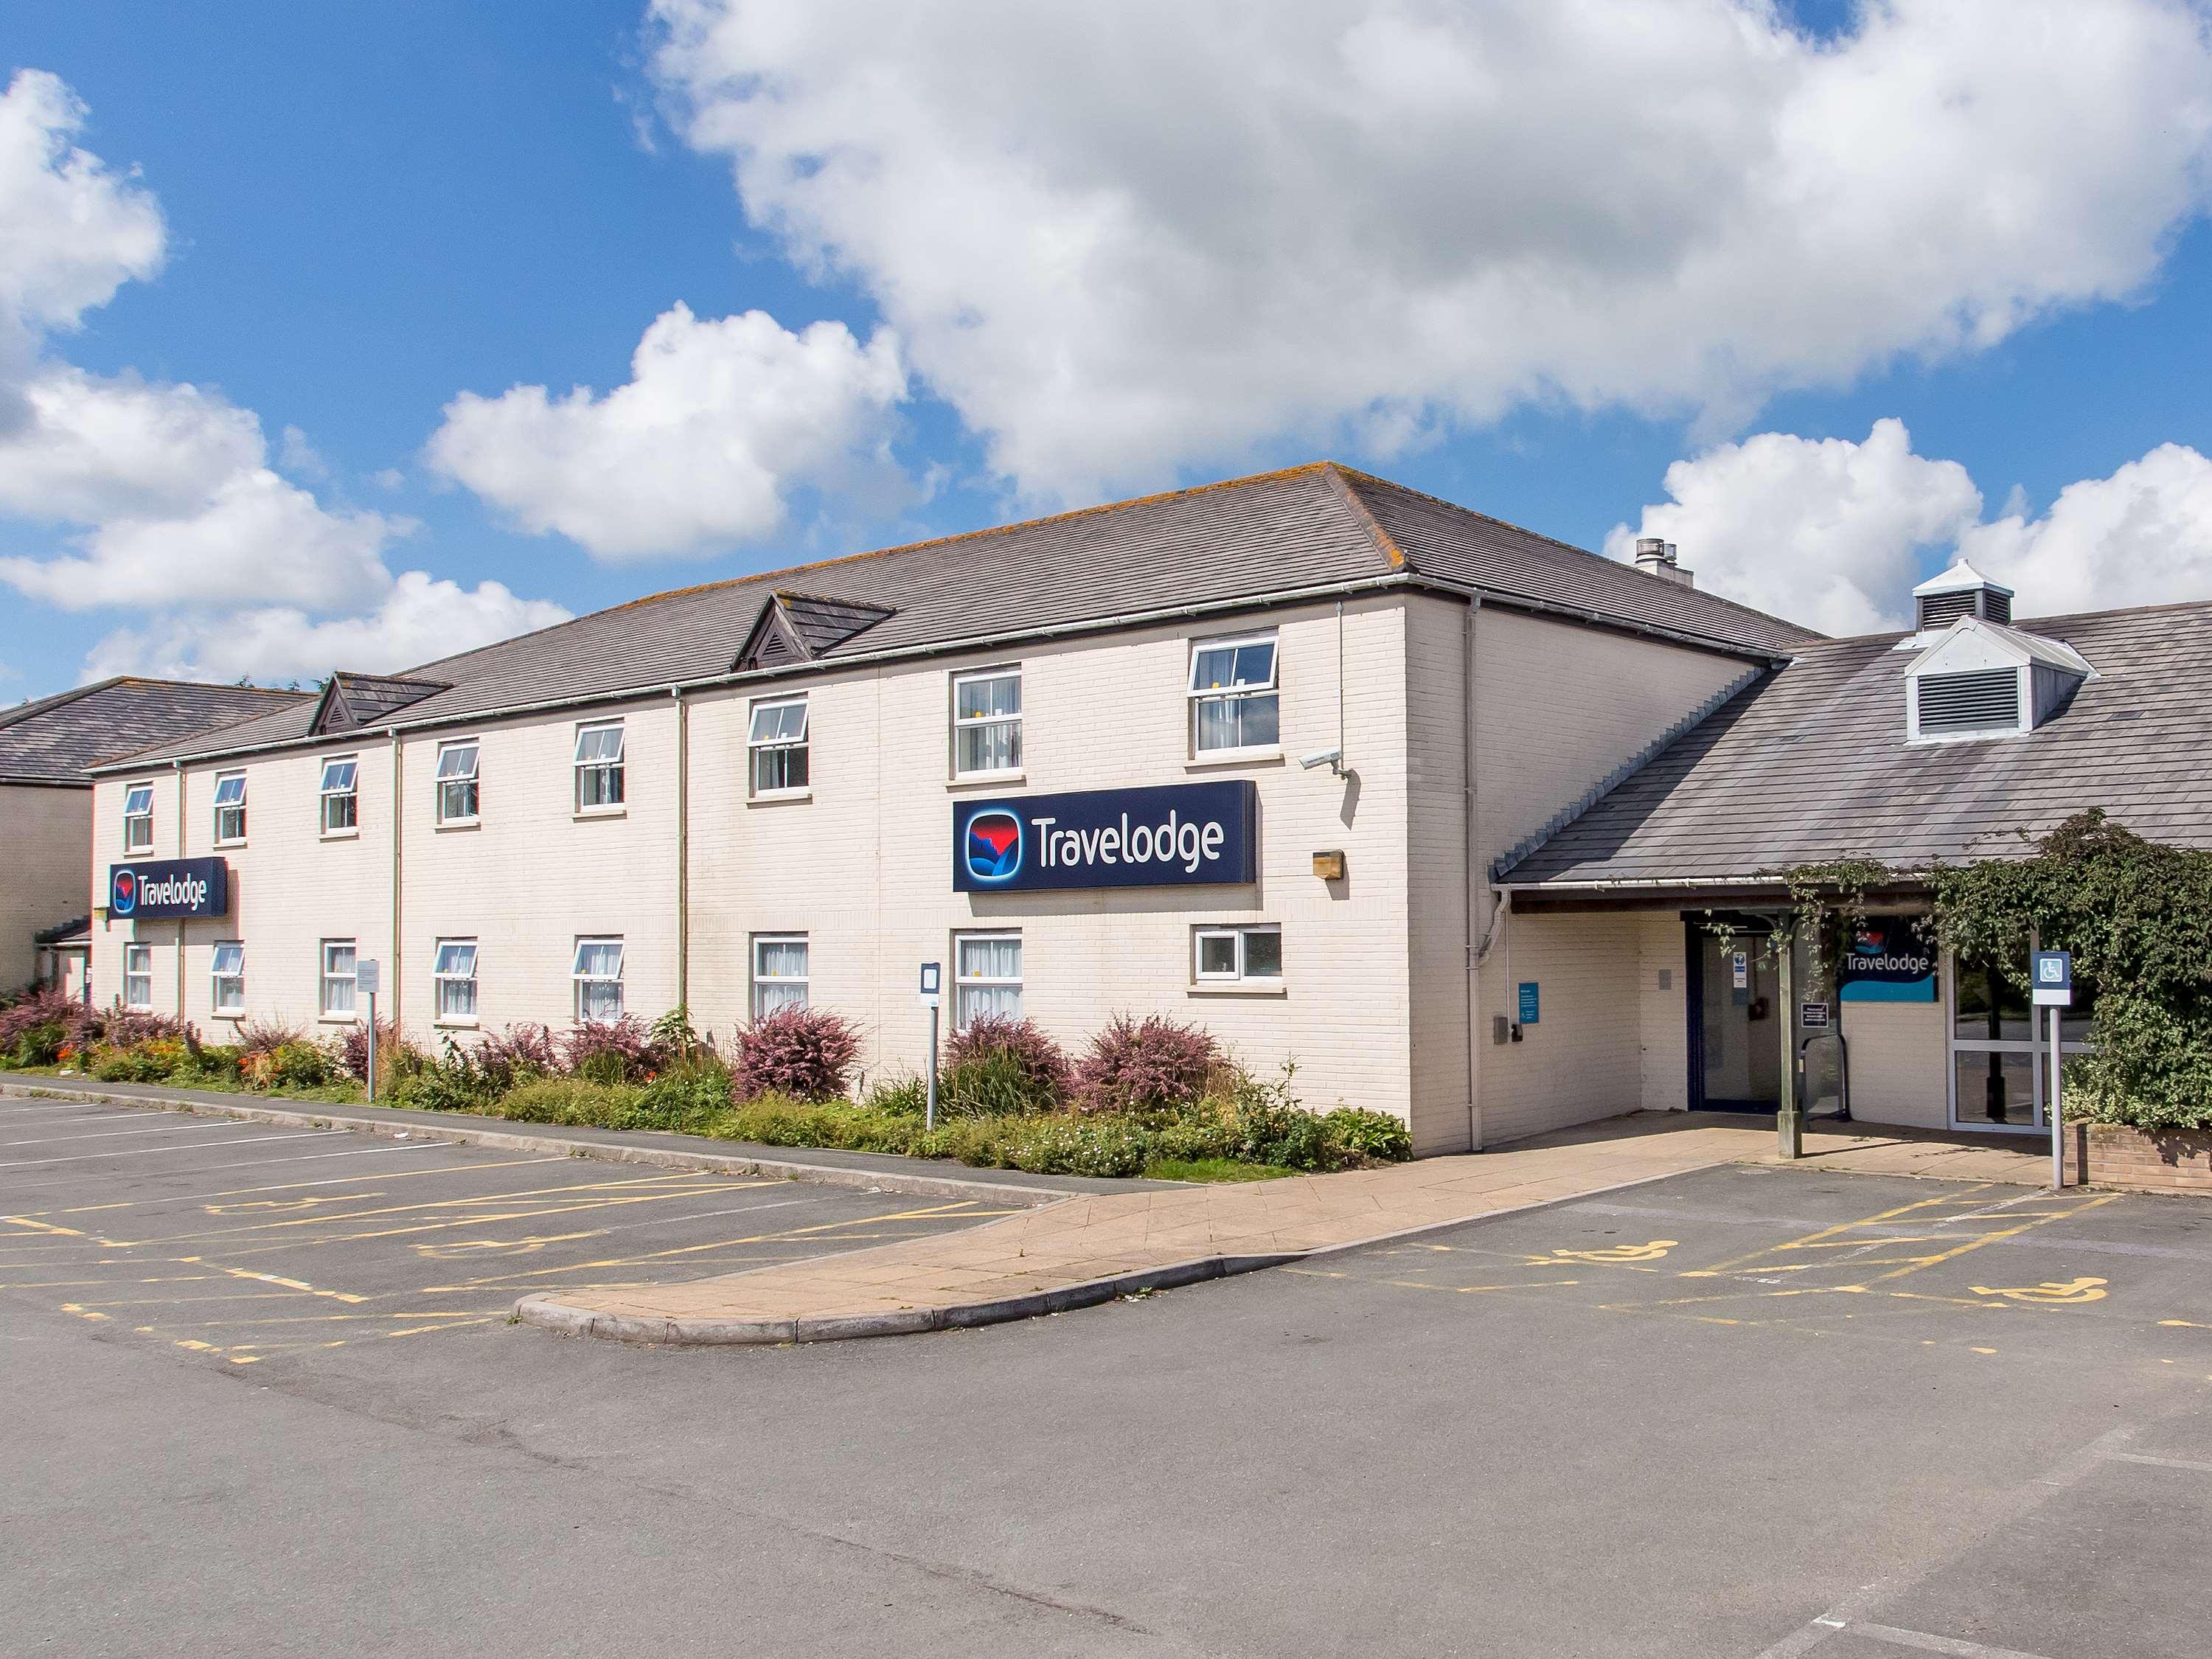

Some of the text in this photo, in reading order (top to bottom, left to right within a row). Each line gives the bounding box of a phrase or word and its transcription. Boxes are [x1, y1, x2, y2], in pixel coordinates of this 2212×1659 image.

[1031, 810, 1224, 873] Travelodge
[138, 873, 206, 911] Travelodge
[1846, 953, 1929, 974] Travelodge
